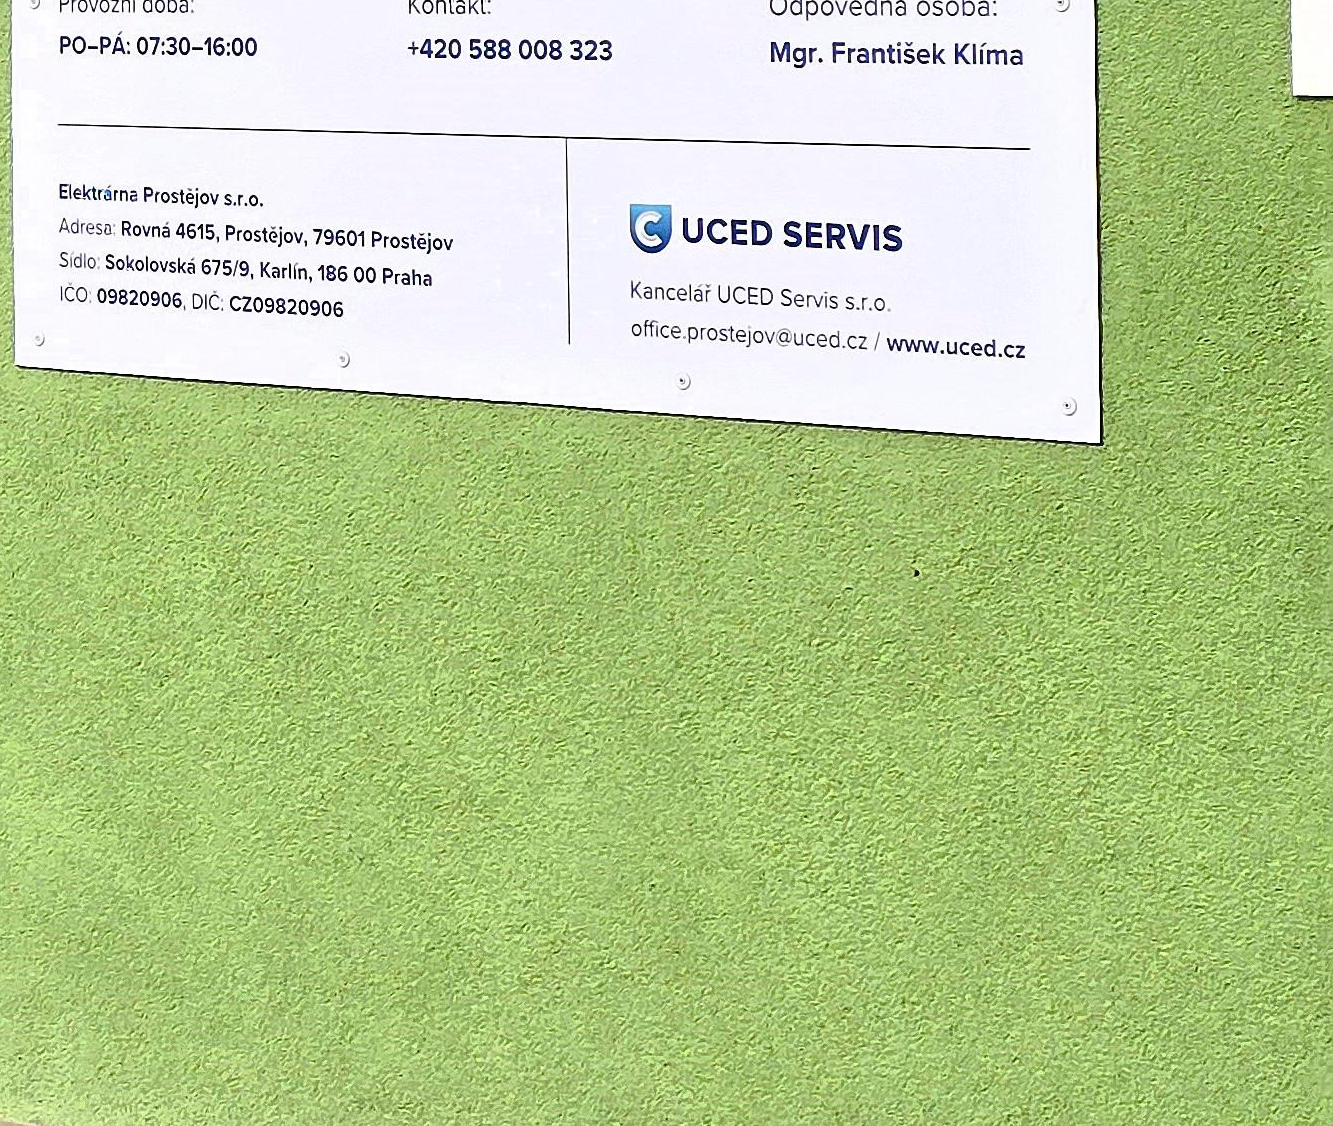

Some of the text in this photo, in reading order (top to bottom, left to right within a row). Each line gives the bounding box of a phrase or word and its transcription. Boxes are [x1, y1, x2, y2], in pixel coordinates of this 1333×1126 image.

[60, 31, 257, 56] PO–PÁ: 07:30–16:00
[407, 39, 612, 61] +420 588 008 323
[771, 42, 1023, 68] Mgr. František Klíma
[59, 184, 263, 209] Elektrárna Prostějov s.r.o.
[59, 218, 453, 254] Adresa: Rovná 4615, Prostějov, 79601 Prostějov
[683, 218, 902, 252] UCED SERVIS
[59, 252, 432, 286] Sídlo: Sokolovská 675/9, Karlín, 186 00 Praha
[61, 282, 343, 317] IČO: 09820906, DIČ: CZ09820906
[631, 280, 891, 312] Kancelář UCED Servis s.r.o.
[632, 320, 1025, 358] office.prostejov@uced.cz / www.uced.cz
